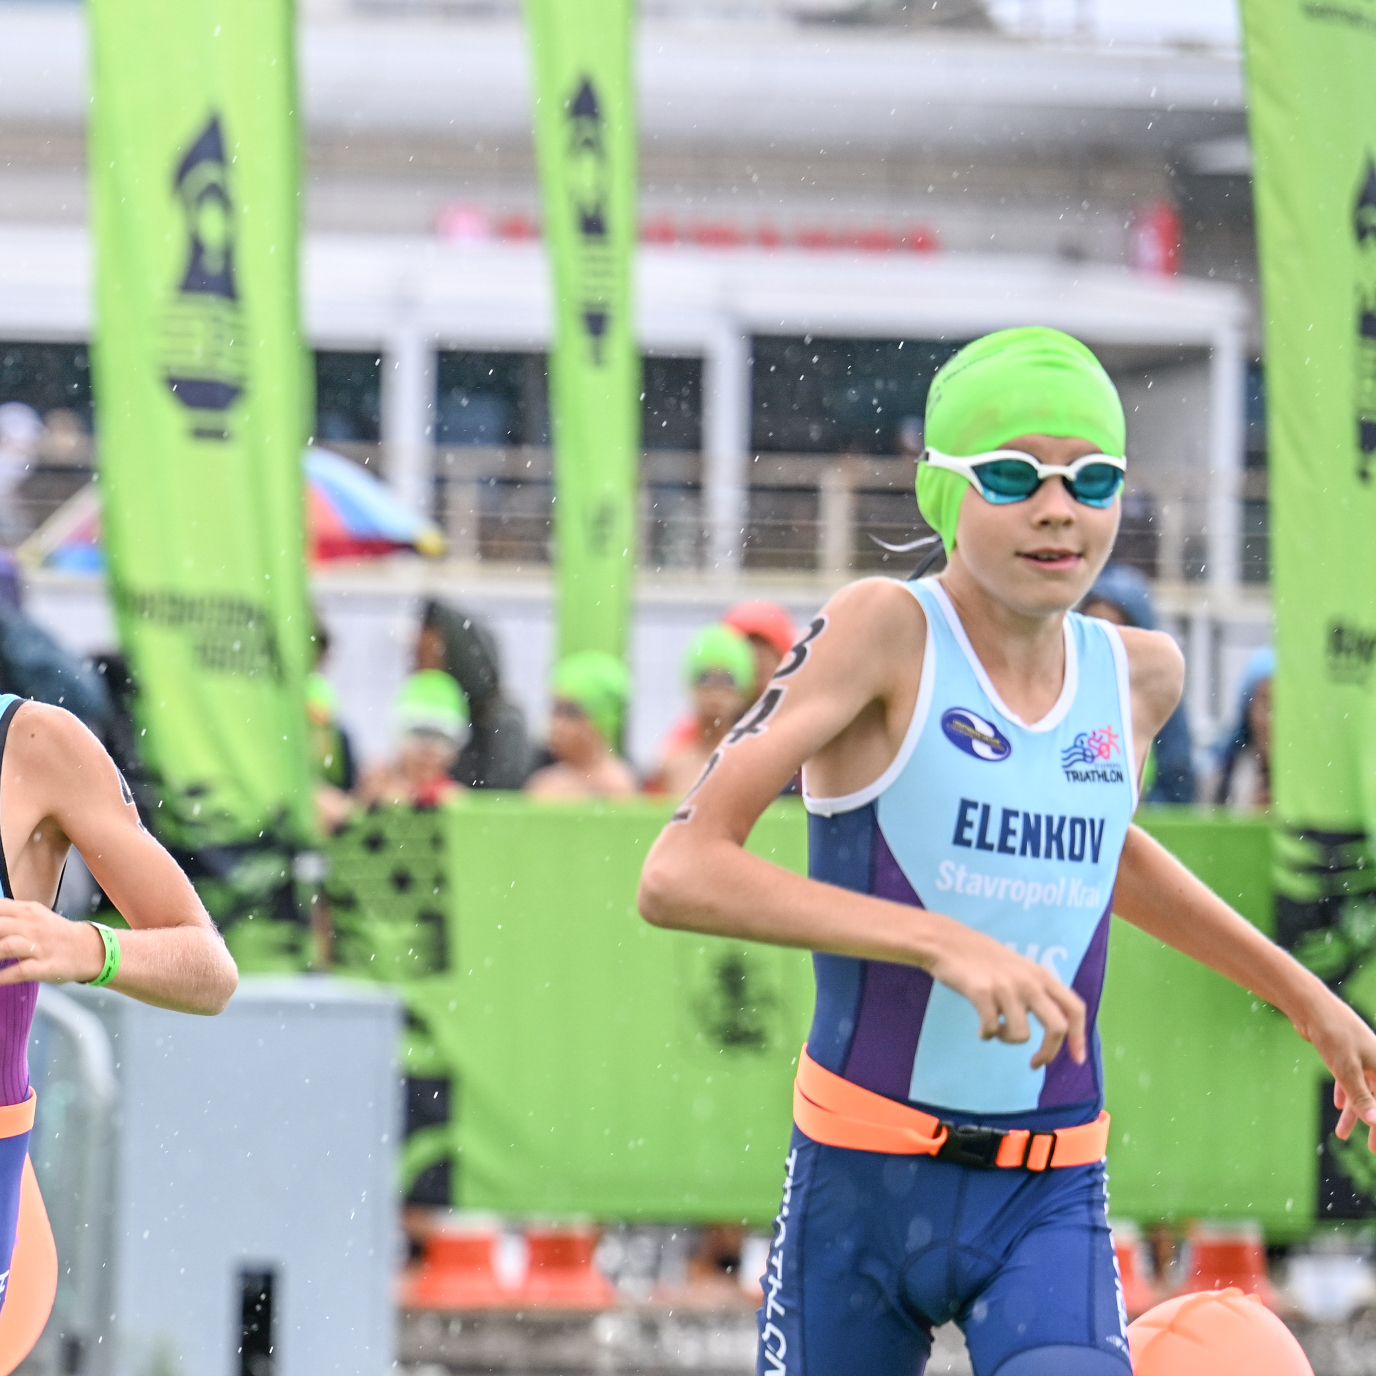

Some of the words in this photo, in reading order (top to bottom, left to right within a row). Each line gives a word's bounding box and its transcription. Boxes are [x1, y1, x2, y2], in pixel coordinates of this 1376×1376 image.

[1065, 769, 1124, 783] TRIATHLON
[952, 797, 1105, 864] ELENKOV
[935, 859, 1067, 910] Stavropol
